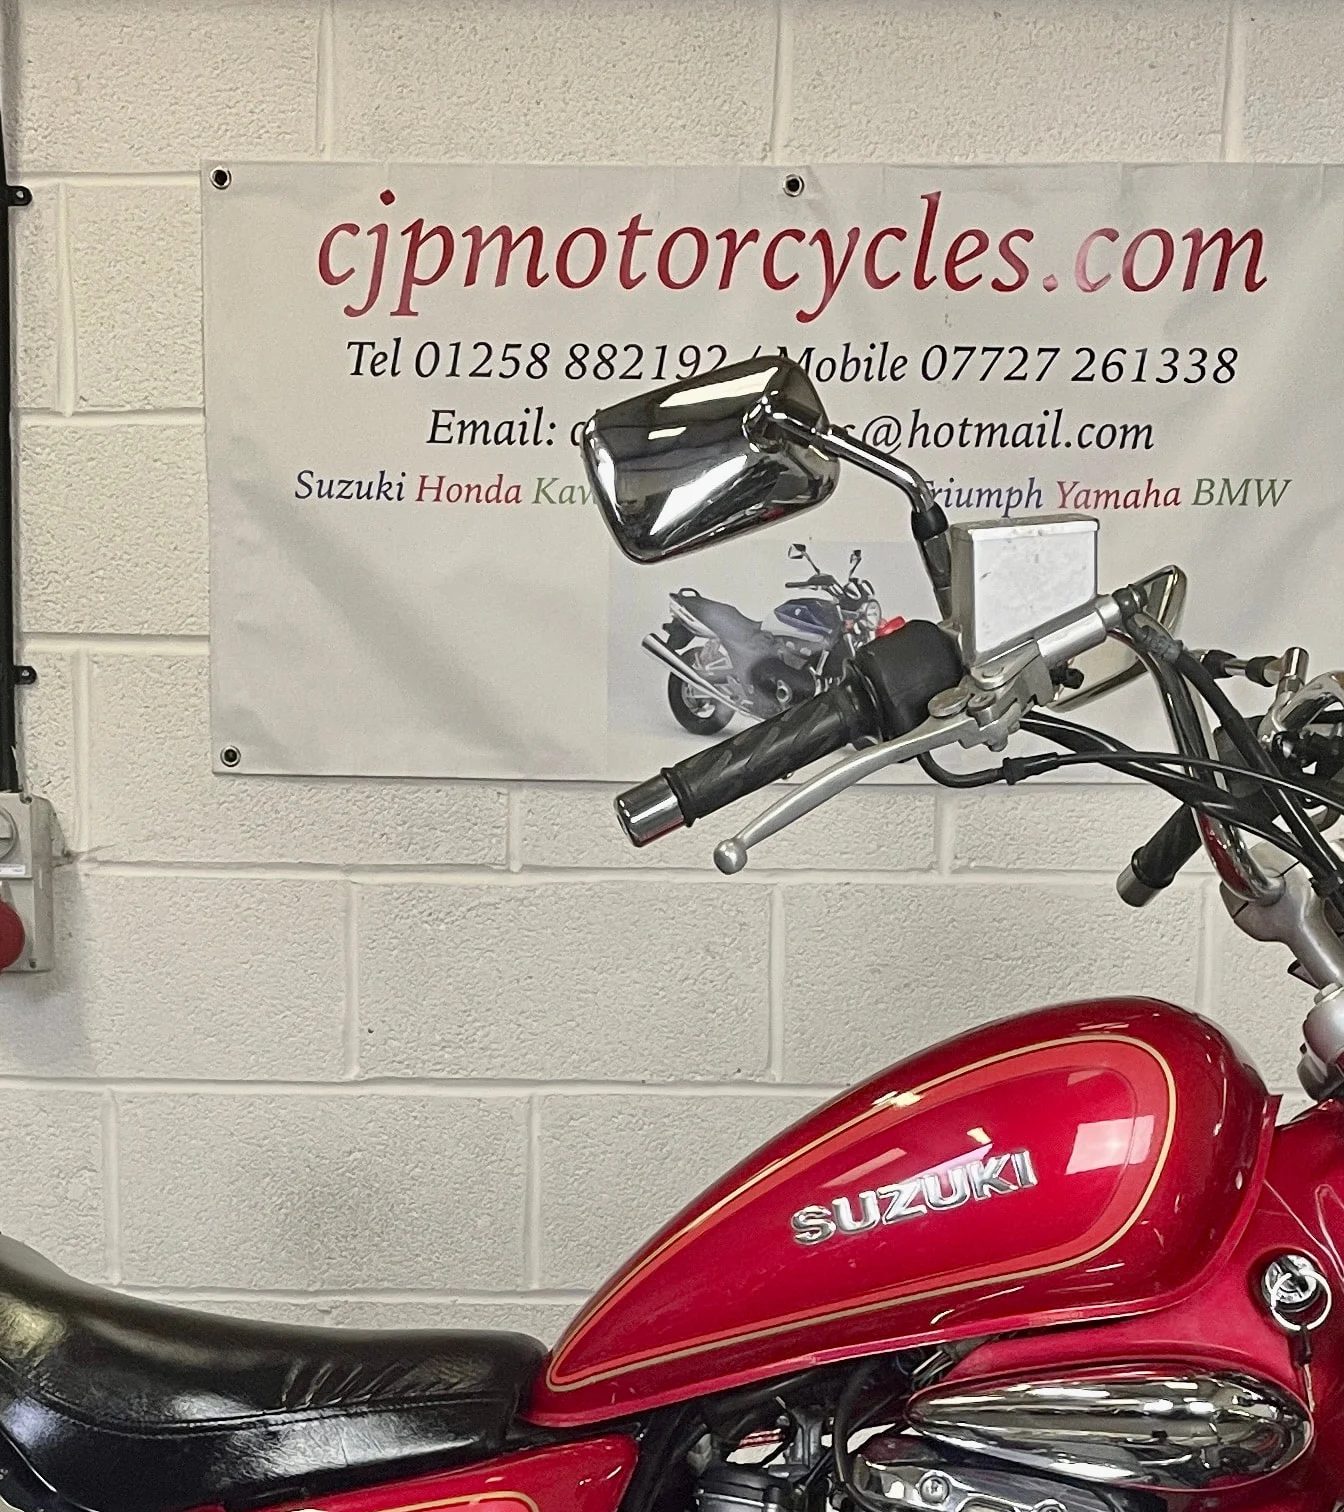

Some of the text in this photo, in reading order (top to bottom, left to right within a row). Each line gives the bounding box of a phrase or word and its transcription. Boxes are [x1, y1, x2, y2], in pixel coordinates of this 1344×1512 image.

[317, 189, 1269, 324] cjpmotorcycles.com
[346, 337, 403, 378] Tel
[414, 341, 552, 380] 01258
[564, 343, 727, 381] 882192
[921, 344, 1061, 383] 07727
[1070, 347, 1240, 384] 261338
[426, 406, 558, 447] Email:
[294, 469, 407, 503] Suzuki
[415, 473, 524, 505] Honda
[1056, 477, 1182, 511] Yamaha
[1191, 477, 1293, 509] BMW
[790, 1149, 1039, 1245] SUZUKI
